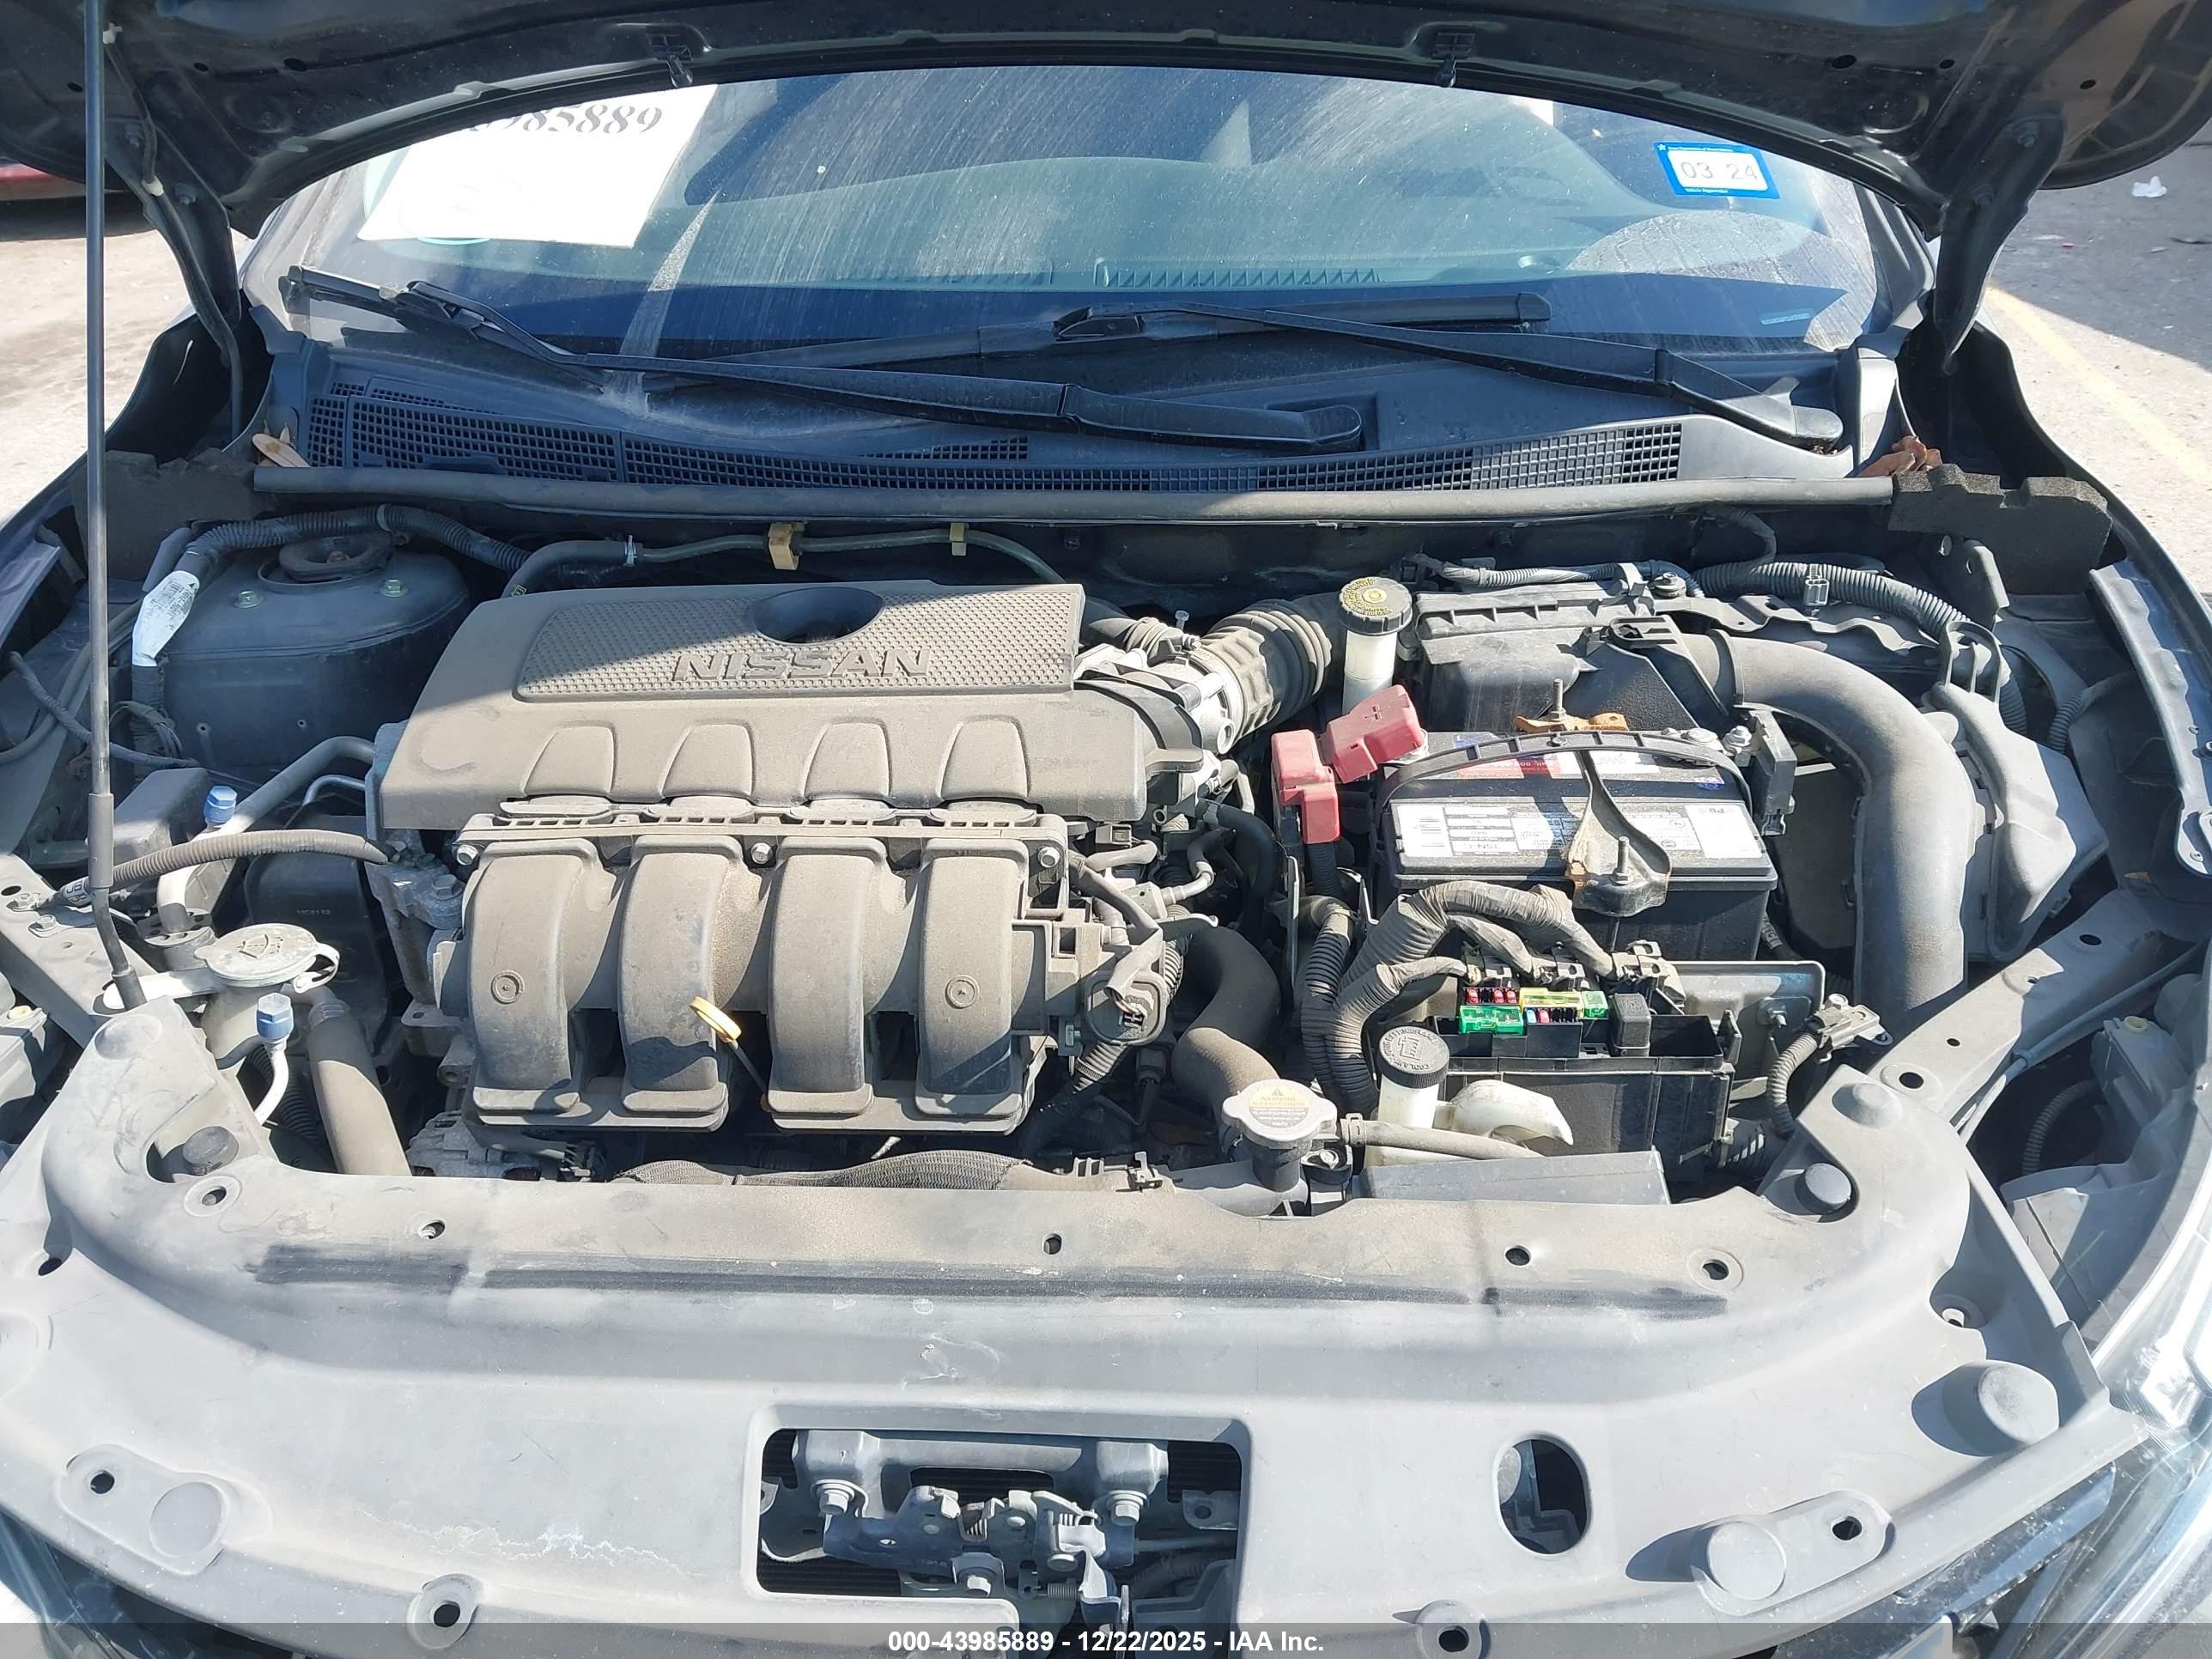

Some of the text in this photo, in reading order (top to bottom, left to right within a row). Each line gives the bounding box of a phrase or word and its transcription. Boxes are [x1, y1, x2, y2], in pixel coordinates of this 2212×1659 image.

[1680, 161, 1758, 180] 03 24
[672, 649, 931, 682] NISSAN
